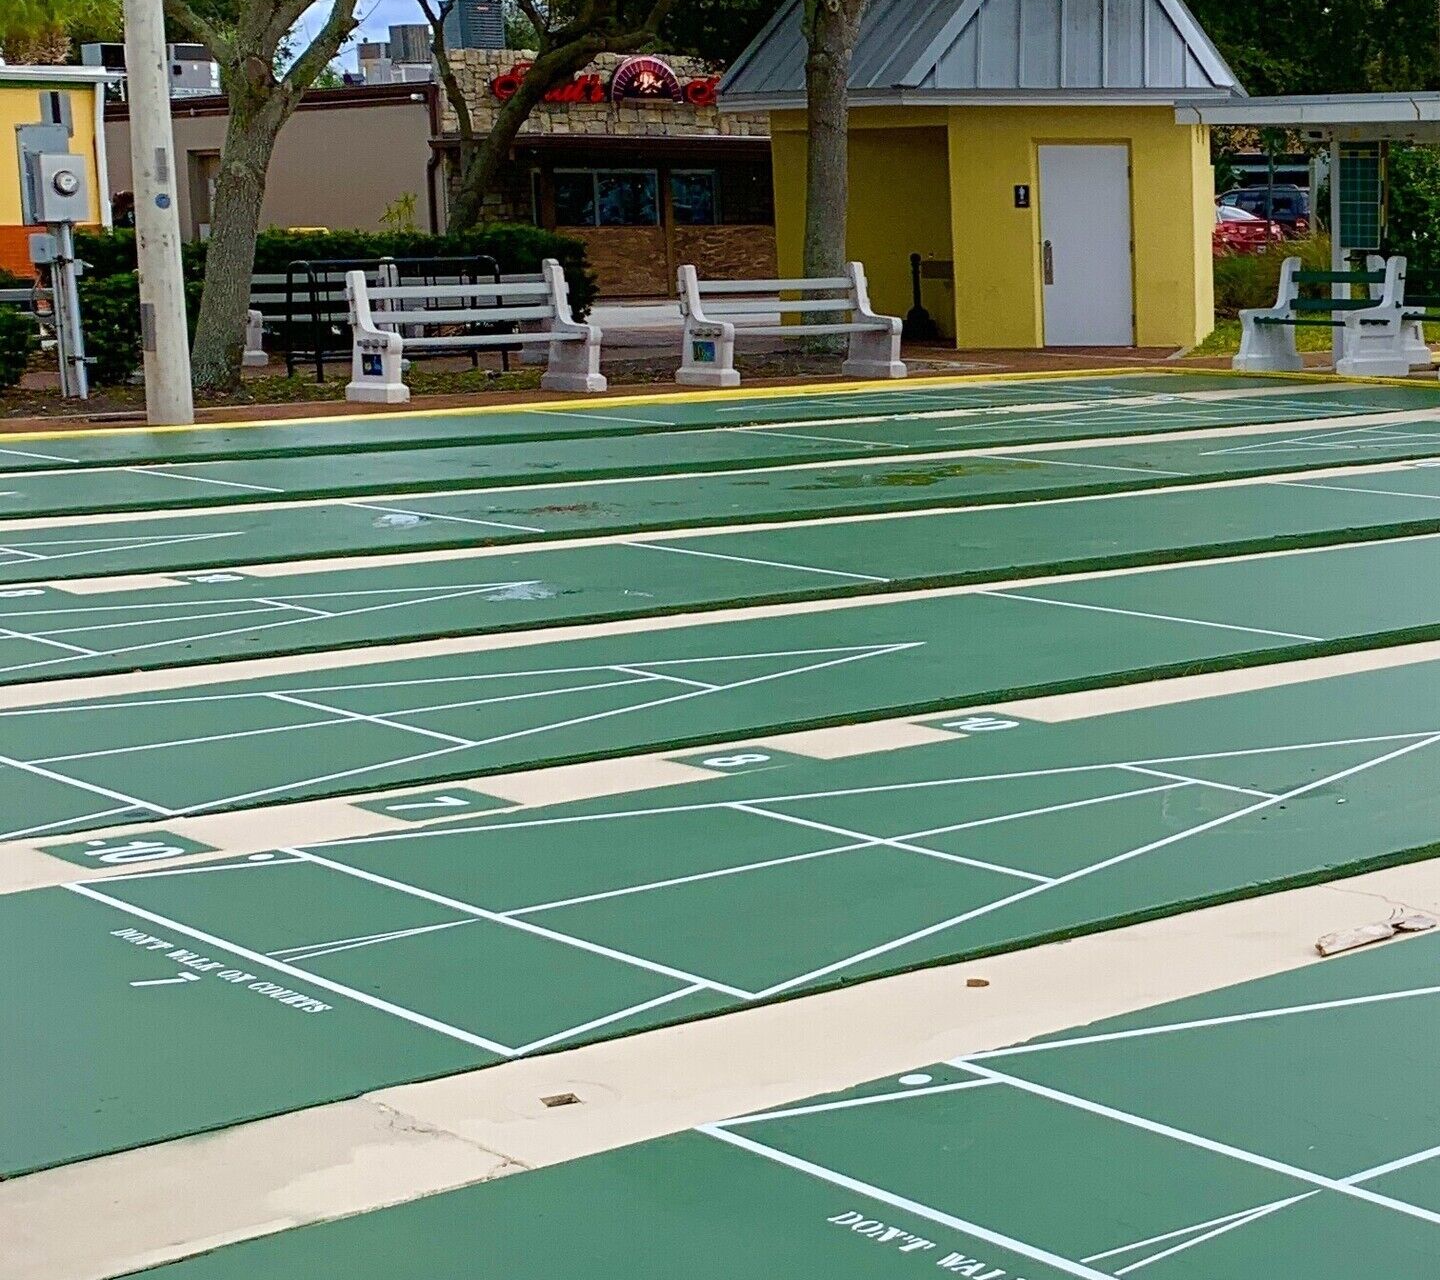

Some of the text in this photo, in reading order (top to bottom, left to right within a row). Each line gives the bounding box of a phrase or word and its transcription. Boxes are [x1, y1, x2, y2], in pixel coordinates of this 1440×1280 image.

[943, 717, 1020, 732] 10
[703, 753, 770, 767] 8
[385, 796, 471, 811] 7
[129, 971, 201, 987] 7
[165, 948, 226, 972] WALK
[216, 969, 257, 983] ON
[247, 981, 334, 1013] COURTS
[827, 1210, 937, 1252] DON'T
